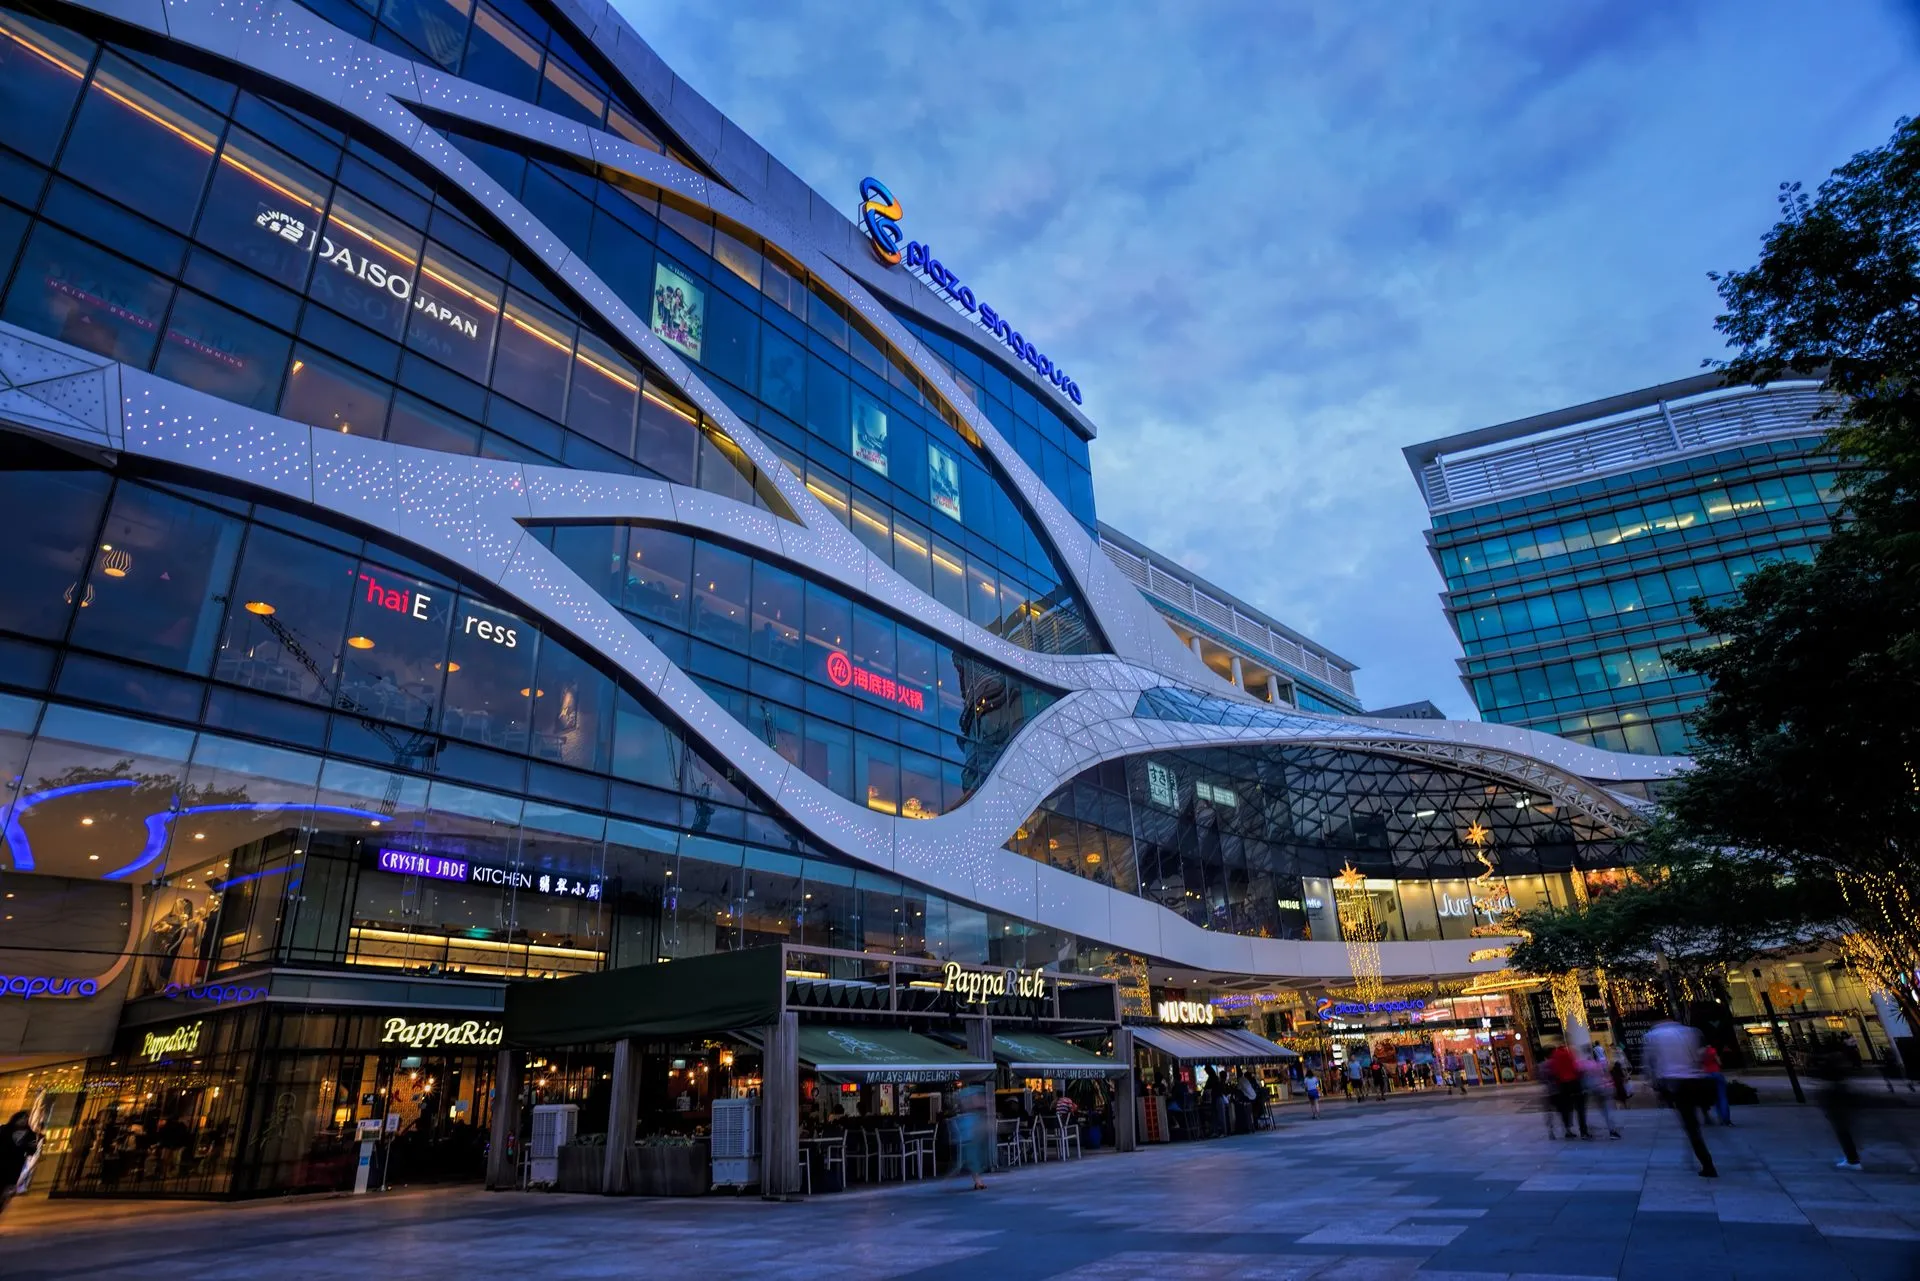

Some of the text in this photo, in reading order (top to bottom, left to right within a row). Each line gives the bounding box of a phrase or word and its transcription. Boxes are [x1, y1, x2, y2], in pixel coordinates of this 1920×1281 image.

[256, 210, 305, 231] ALWAYS
[306, 230, 478, 338] DAISO JAPAN
[50, 280, 86, 300] HAIR
[184, 338, 243, 368] SLIMMING
[907, 240, 1083, 405] plaza singapura
[853, 666, 924, 712] 海底捞火锅
[382, 851, 533, 889] CRYSTAL JADE KITCHEN
[943, 961, 1045, 1004] PappaRich
[1158, 1000, 1214, 1025] MUCHOS
[1335, 999, 1425, 1016] plaza singapura
[140, 1021, 203, 1062] PappaRich
[382, 1017, 504, 1048] PappaRic
[866, 1070, 960, 1084] MALAYSIAN DELIGHTS
[1043, 1069, 1106, 1079] MALAYSIAN DELIGHTS
